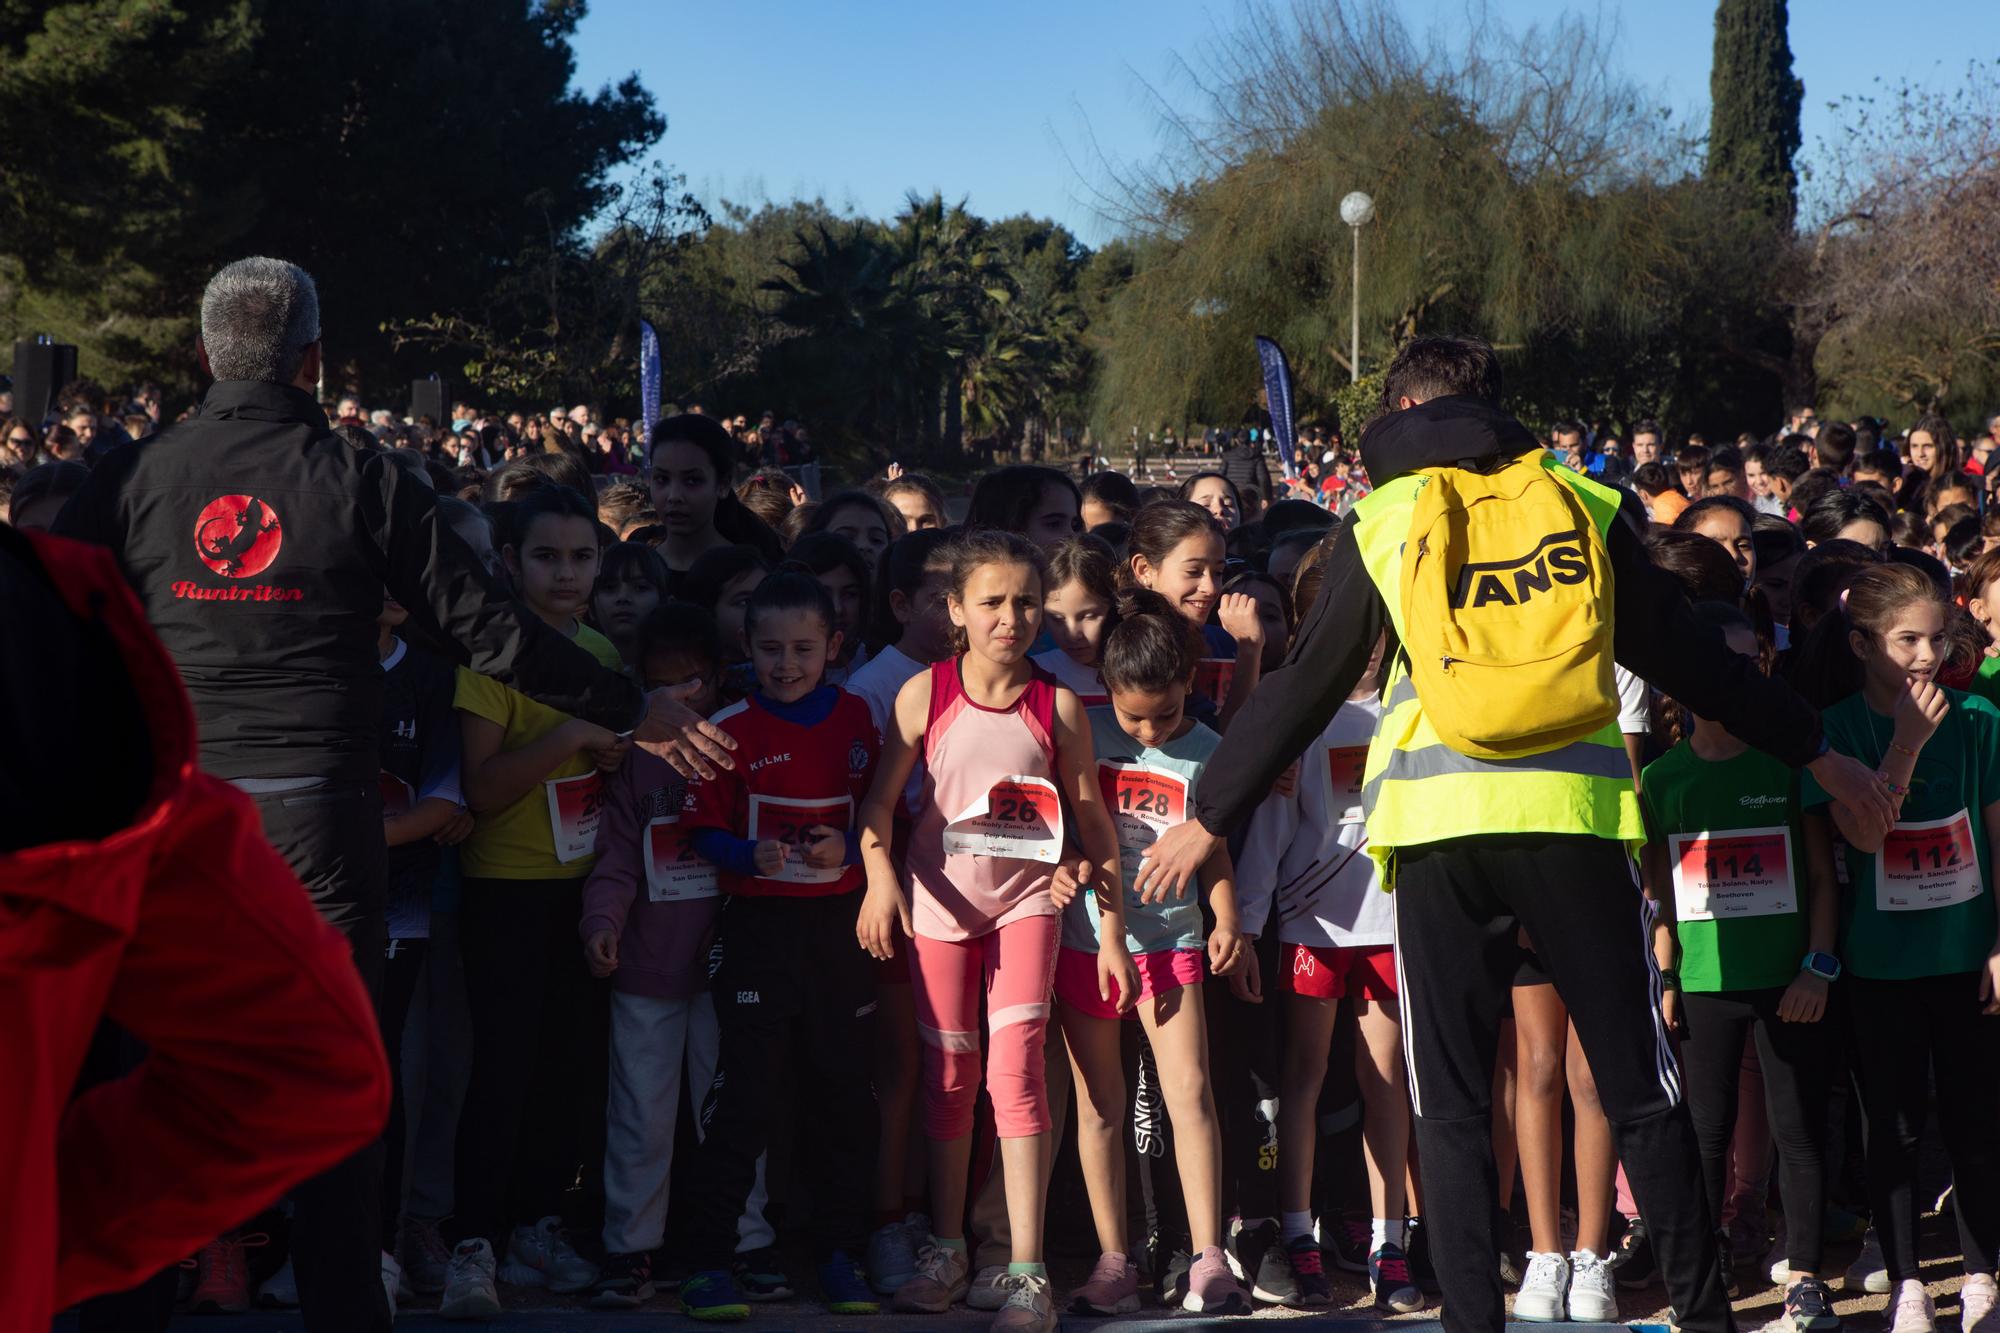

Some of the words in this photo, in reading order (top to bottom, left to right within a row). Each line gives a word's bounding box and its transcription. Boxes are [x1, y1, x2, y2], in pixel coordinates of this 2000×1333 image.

[1449, 530, 1588, 609] VANS
[750, 753, 792, 771] KELME
[1119, 787, 1170, 817] 128
[1738, 794, 1788, 806] Beethoven
[985, 798, 1038, 823] 126
[1122, 822, 1139, 831] Ceip
[1904, 842, 1962, 872] 112
[1705, 853, 1764, 880] 114
[1918, 880, 1957, 891] Beethoven
[1716, 891, 1755, 900] Beethoven
[737, 990, 761, 1004] EGEA
